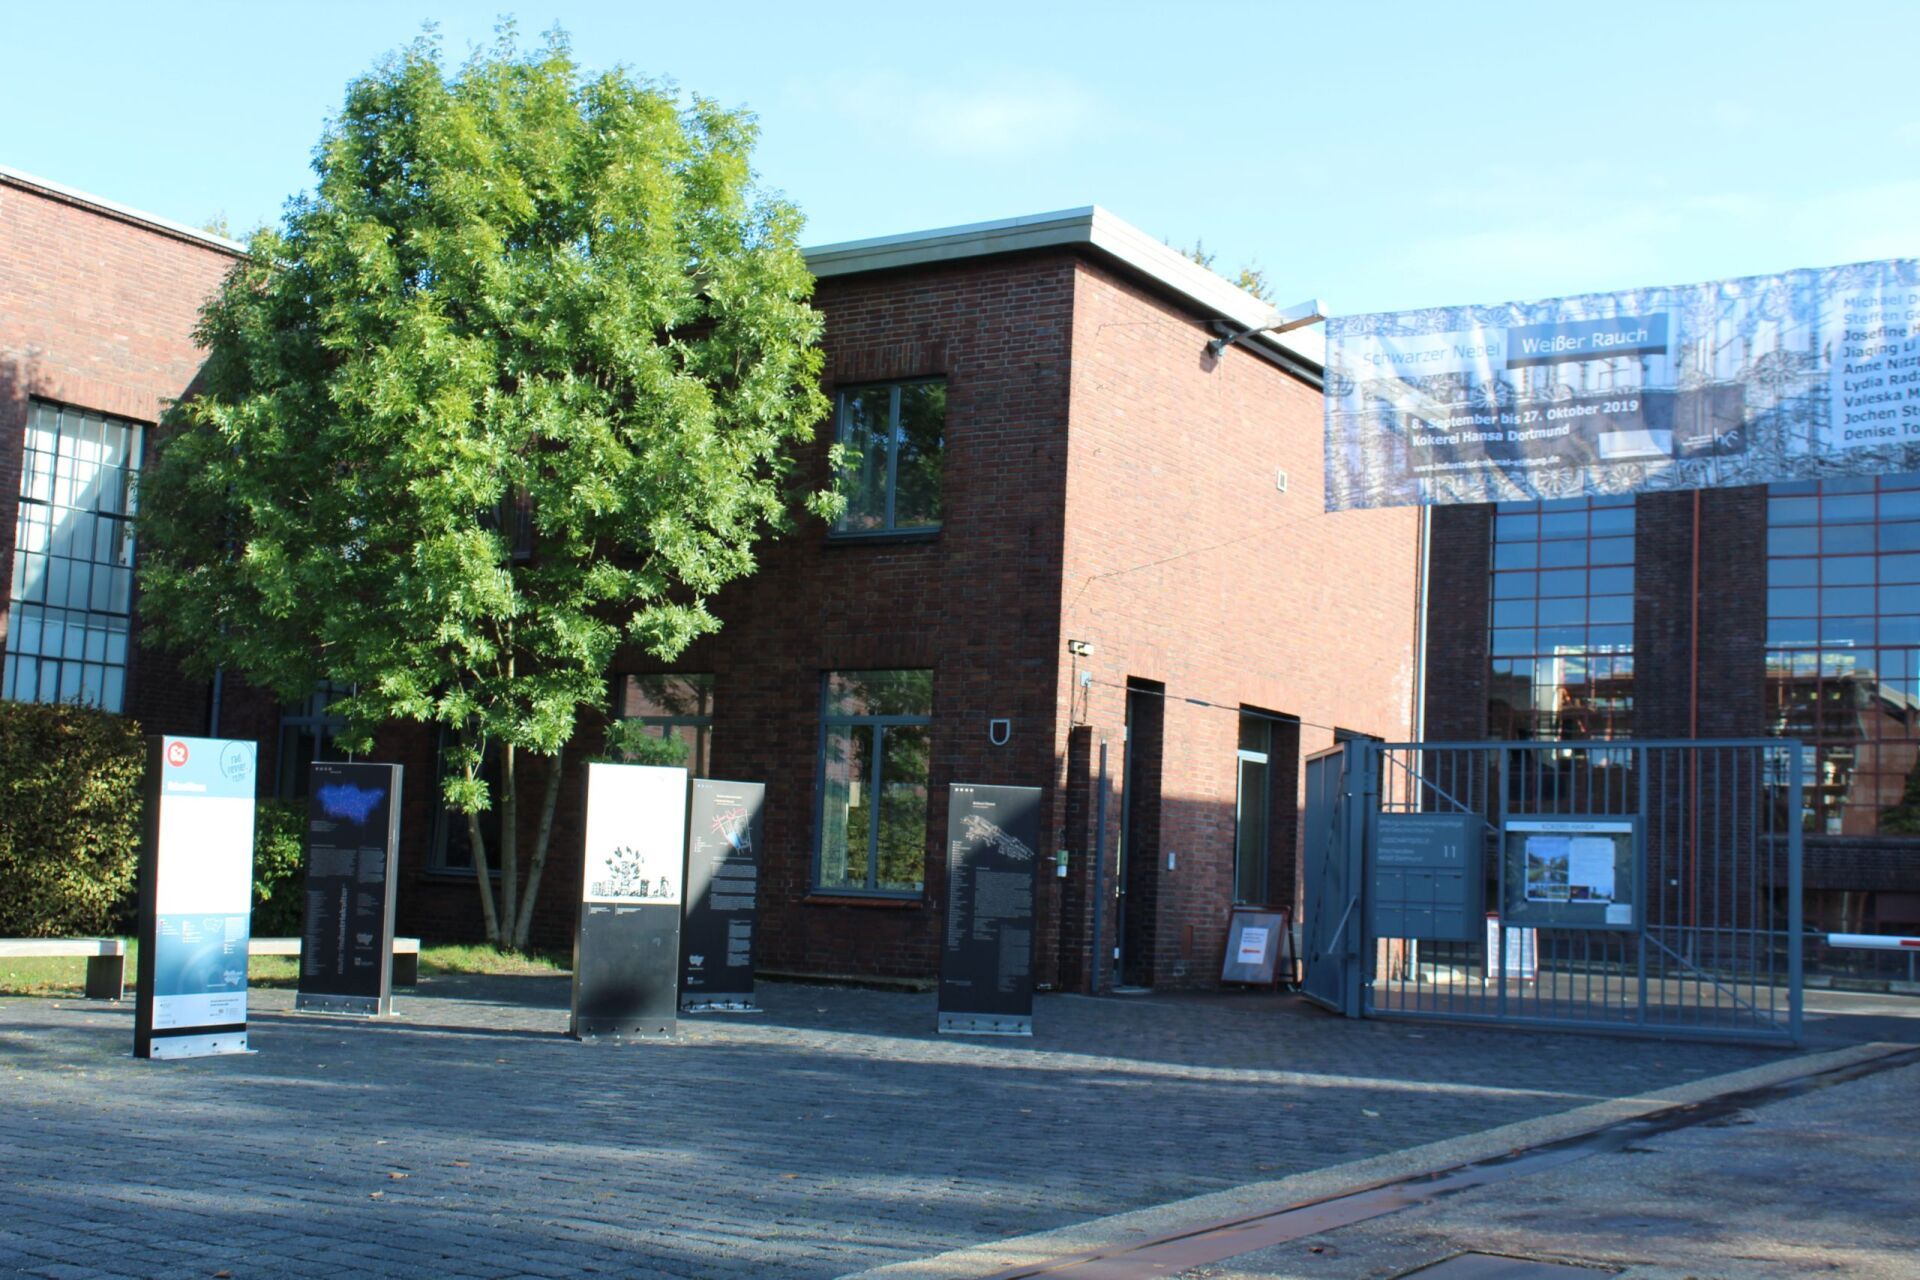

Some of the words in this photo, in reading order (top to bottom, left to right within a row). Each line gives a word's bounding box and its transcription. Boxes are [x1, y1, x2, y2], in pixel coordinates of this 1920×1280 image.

[1843, 294, 1902, 308] Michael
[1908, 293, 1920, 305] D
[1843, 310, 1899, 325] Steffen
[1521, 335, 1587, 354] Weißer
[1591, 327, 1649, 348] Rauch
[1842, 326, 1907, 341] Josefine
[1362, 347, 1448, 367] Schwarzer
[1453, 341, 1500, 360] Nebel
[1842, 342, 1899, 359] Jiaqing
[1903, 338, 1917, 352] Li
[1843, 361, 1883, 374] Anne
[1843, 375, 1884, 393] Lydia
[1888, 369, 1920, 386] Rad
[1843, 390, 1903, 408] Valeska
[1411, 418, 1424, 430] 8.
[1427, 413, 1498, 431] September
[1501, 412, 1521, 425] bis
[1523, 409, 1543, 423] 27.
[1546, 403, 1600, 421] Oktober
[1602, 399, 1639, 414] 2019
[1843, 409, 1898, 425] Jochen
[1902, 404, 1920, 418] St
[1412, 431, 1460, 447] Kokerei
[1462, 430, 1504, 443] Hansa
[1507, 423, 1570, 442] Dortmund
[1843, 424, 1897, 441] Denise
